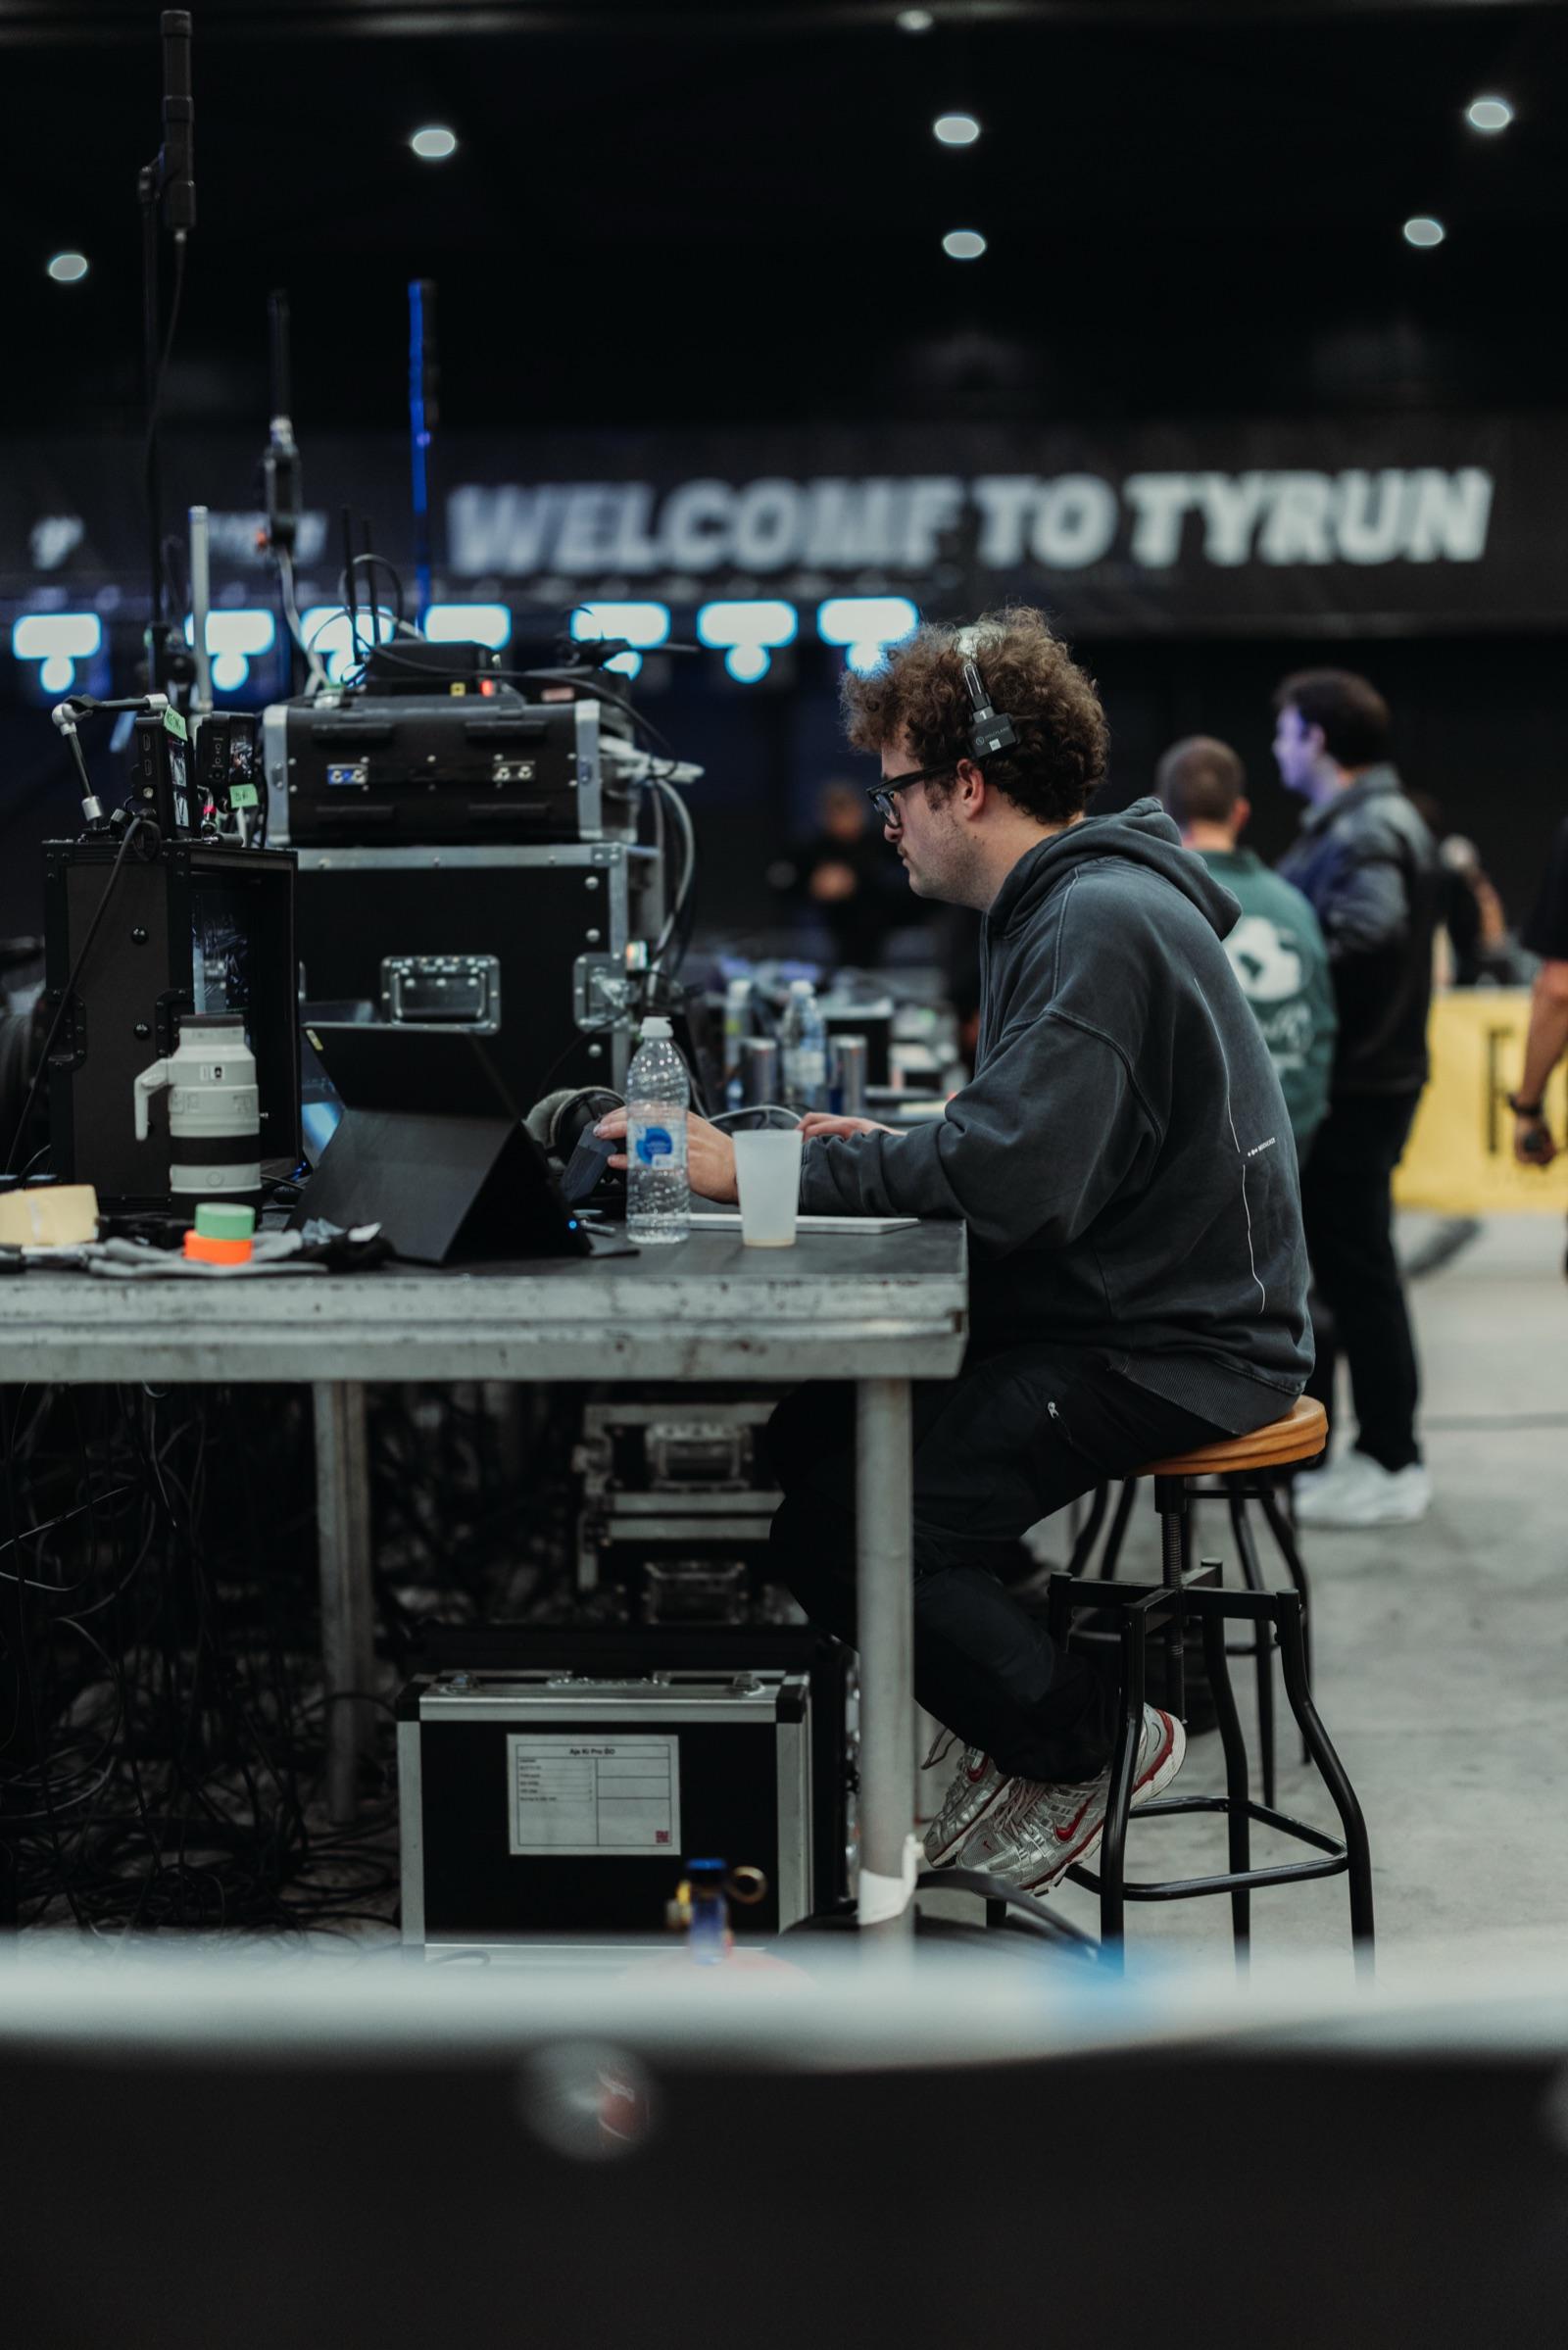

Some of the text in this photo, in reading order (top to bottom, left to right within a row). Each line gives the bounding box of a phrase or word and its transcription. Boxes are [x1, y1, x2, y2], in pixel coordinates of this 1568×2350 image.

[973, 473, 1119, 569] TO
[1124, 466, 1494, 567] TYRUN
[980, 710, 987, 719] 1
